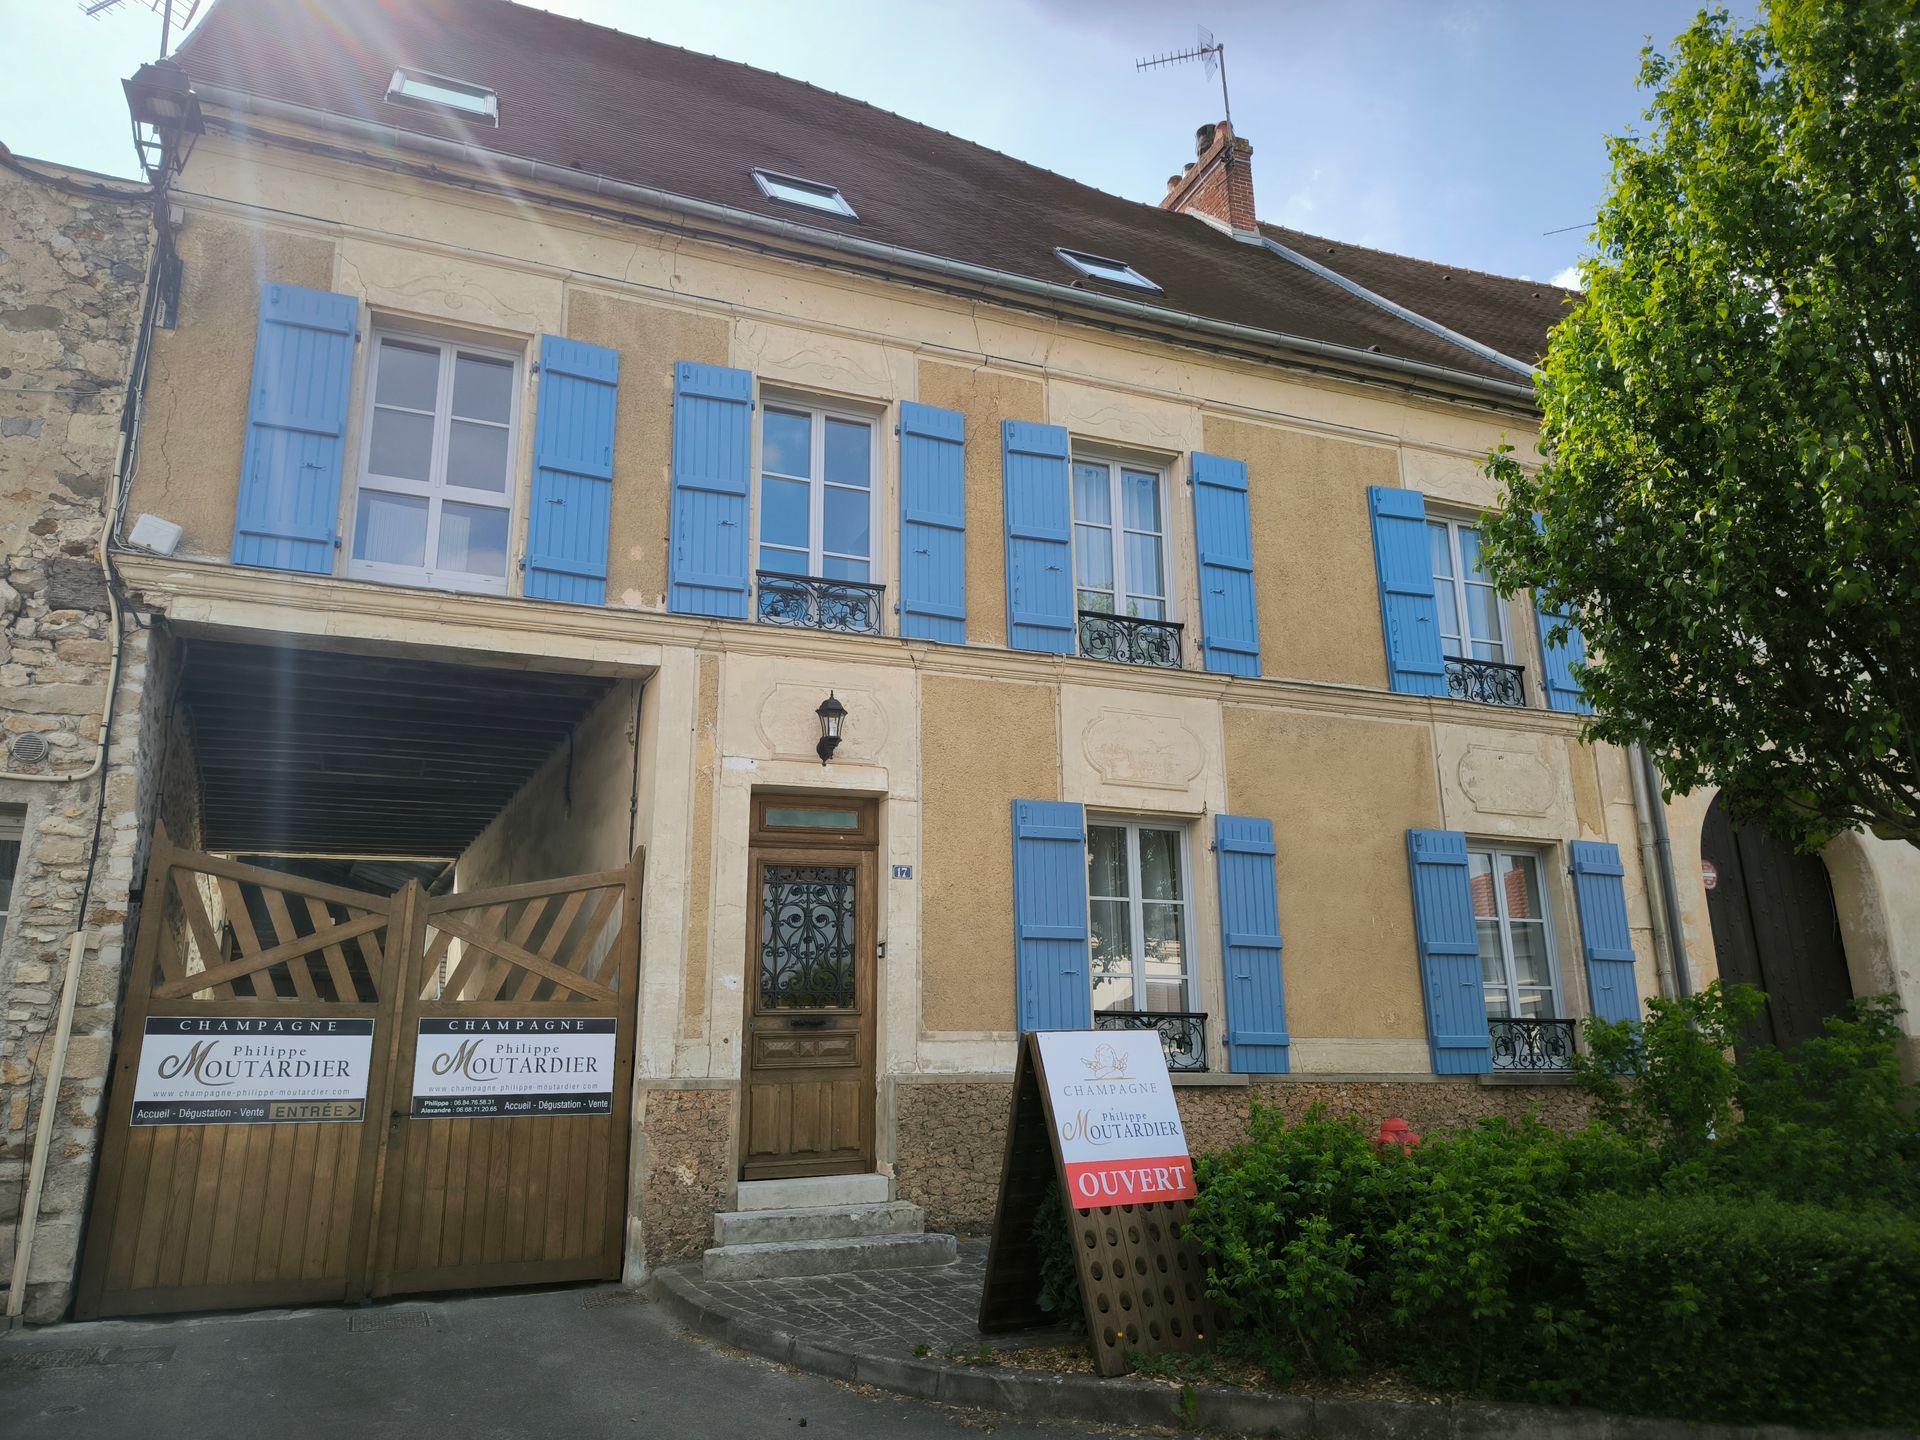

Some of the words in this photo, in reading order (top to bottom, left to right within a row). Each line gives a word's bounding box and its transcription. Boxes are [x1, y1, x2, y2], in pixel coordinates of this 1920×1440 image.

[897, 867, 908, 878] 17
[179, 1020, 337, 1032] CHAMPAGNE
[448, 1020, 585, 1031] CHAMPAGNE
[232, 1045, 308, 1060] Philippe
[496, 1043, 560, 1057] Philippe
[1063, 1082, 1158, 1097] CHAMPAGNE
[137, 1109, 170, 1119] Accueil
[179, 1108, 231, 1119] Dégustation
[240, 1107, 264, 1117] Vente
[275, 1103, 343, 1118] ENTRÉE
[504, 1101, 532, 1110] Accueil
[538, 1100, 582, 1110] Dégustation
[588, 1099, 609, 1108] Vente
[1102, 1111, 1148, 1123] Philippe
[1078, 1165, 1187, 1197] OUVERT
